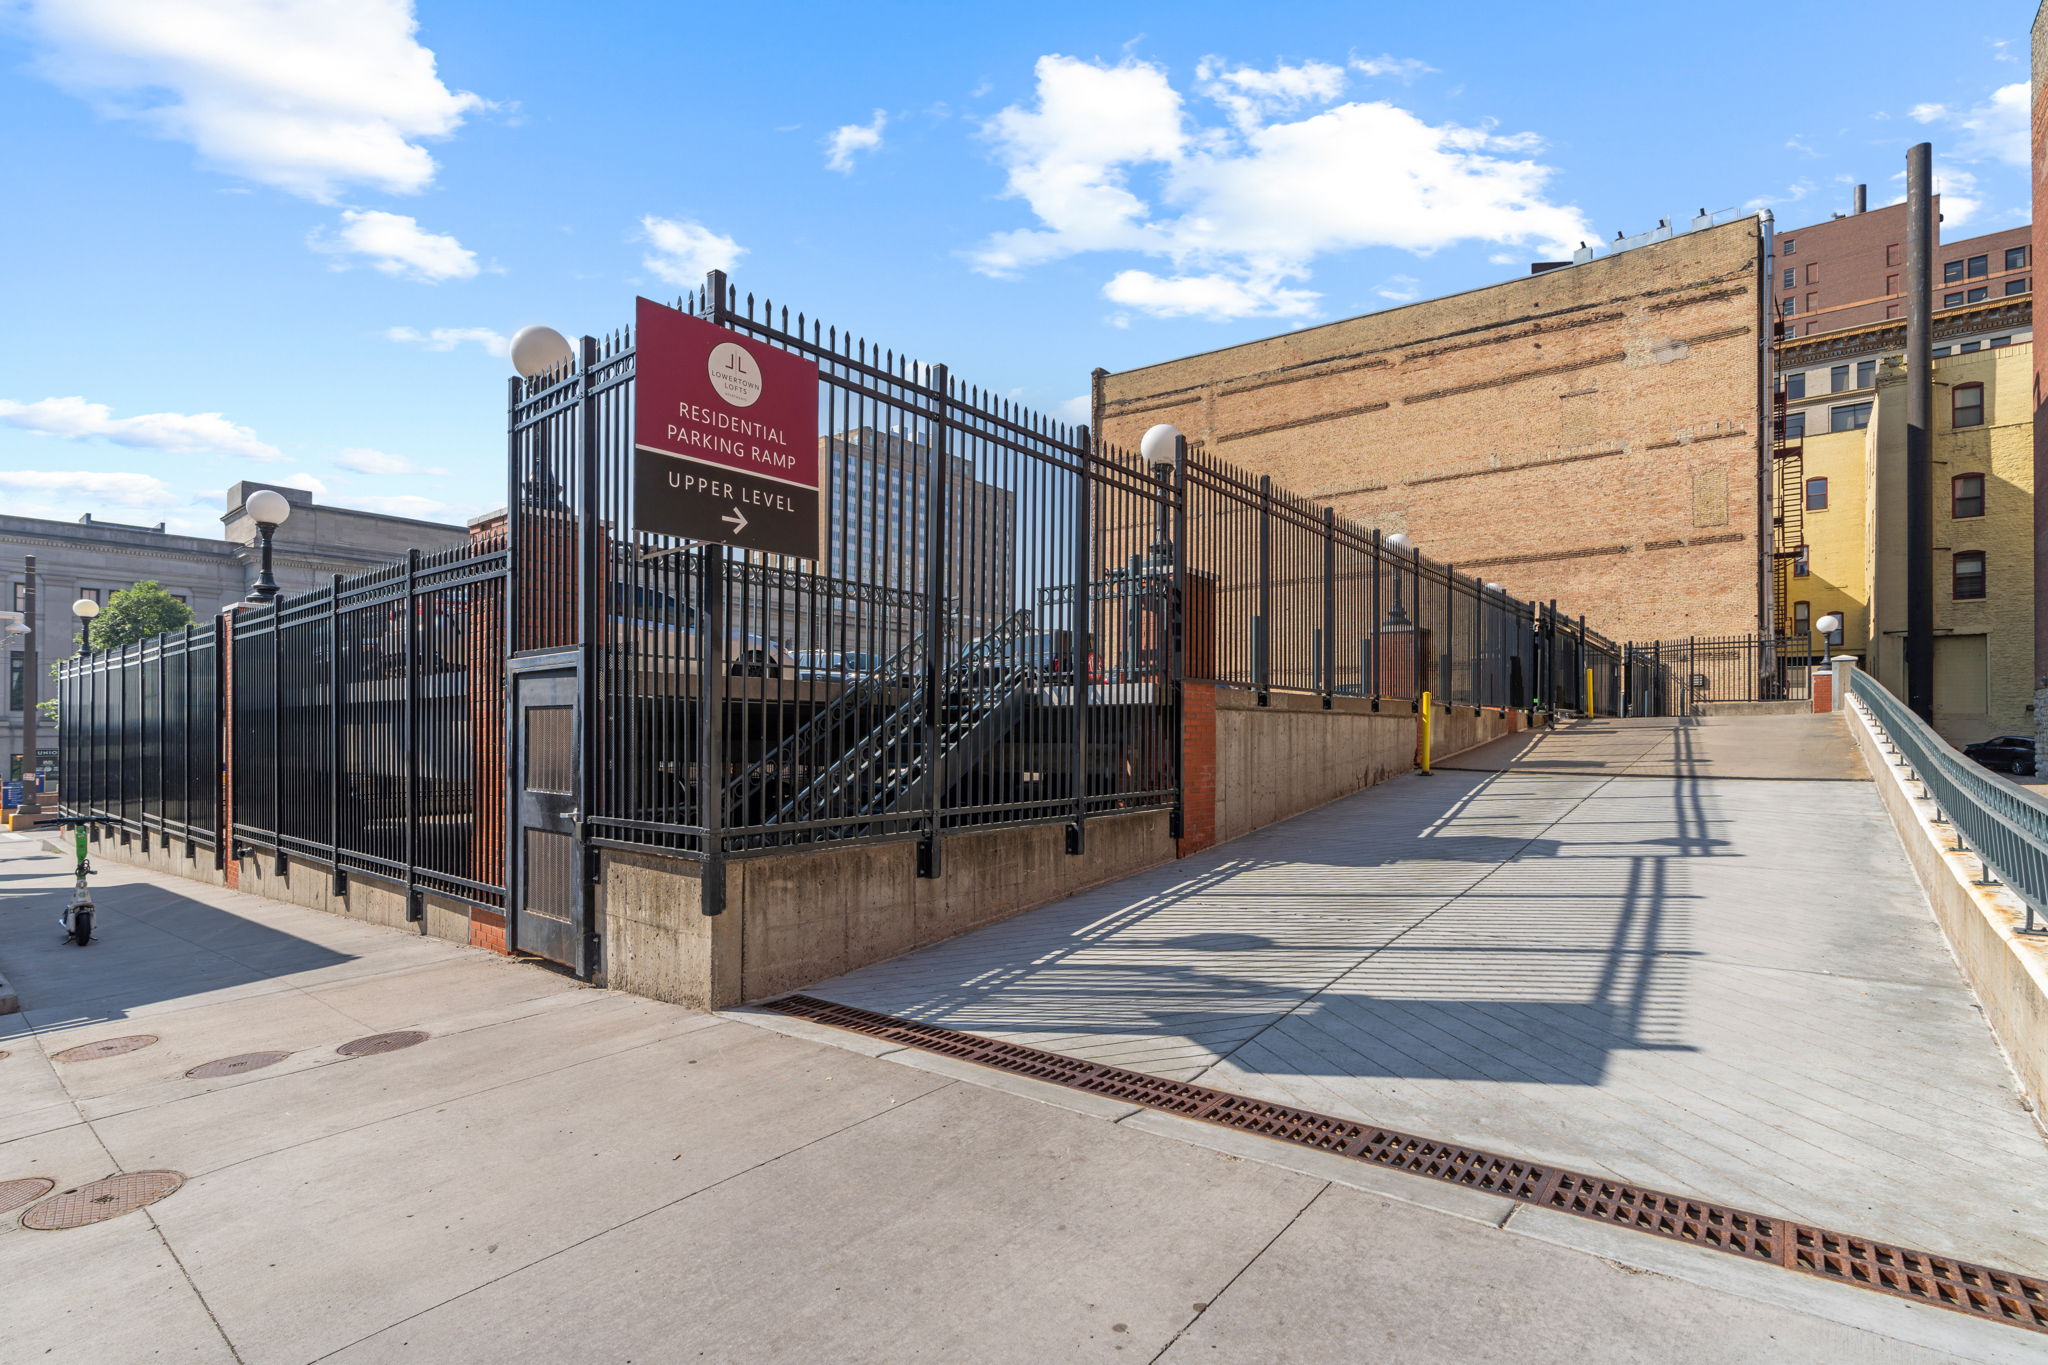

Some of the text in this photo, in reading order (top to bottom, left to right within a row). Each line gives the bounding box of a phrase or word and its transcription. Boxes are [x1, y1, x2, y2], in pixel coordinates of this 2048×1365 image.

[711, 369, 760, 391] LOWERTOWN
[724, 382, 748, 395] LOFTS
[679, 401, 787, 446] RESIDENTIAL
[668, 424, 796, 470] PARKING RAMP
[669, 471, 795, 512] UPPER LEVEL
